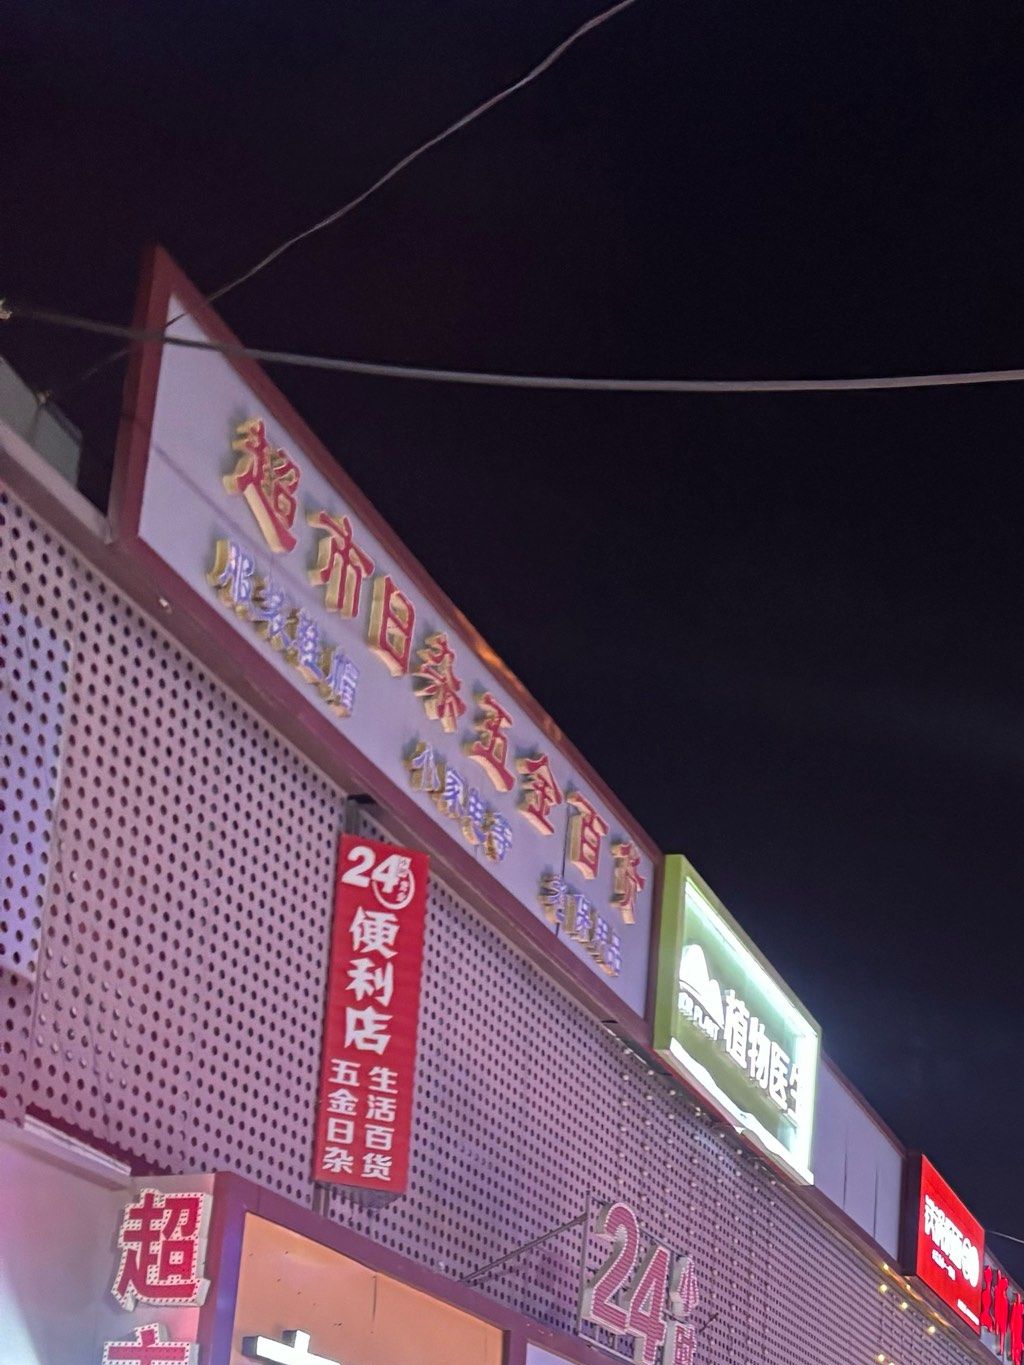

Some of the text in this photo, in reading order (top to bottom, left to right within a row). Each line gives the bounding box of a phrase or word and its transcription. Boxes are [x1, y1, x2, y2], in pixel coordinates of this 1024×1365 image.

[222, 417, 646, 924] 超市日杂五金百货
[343, 905, 400, 1055] 便利店
[322, 1058, 361, 1176] 五金日杂
[361, 1065, 399, 1183] 生活百货
